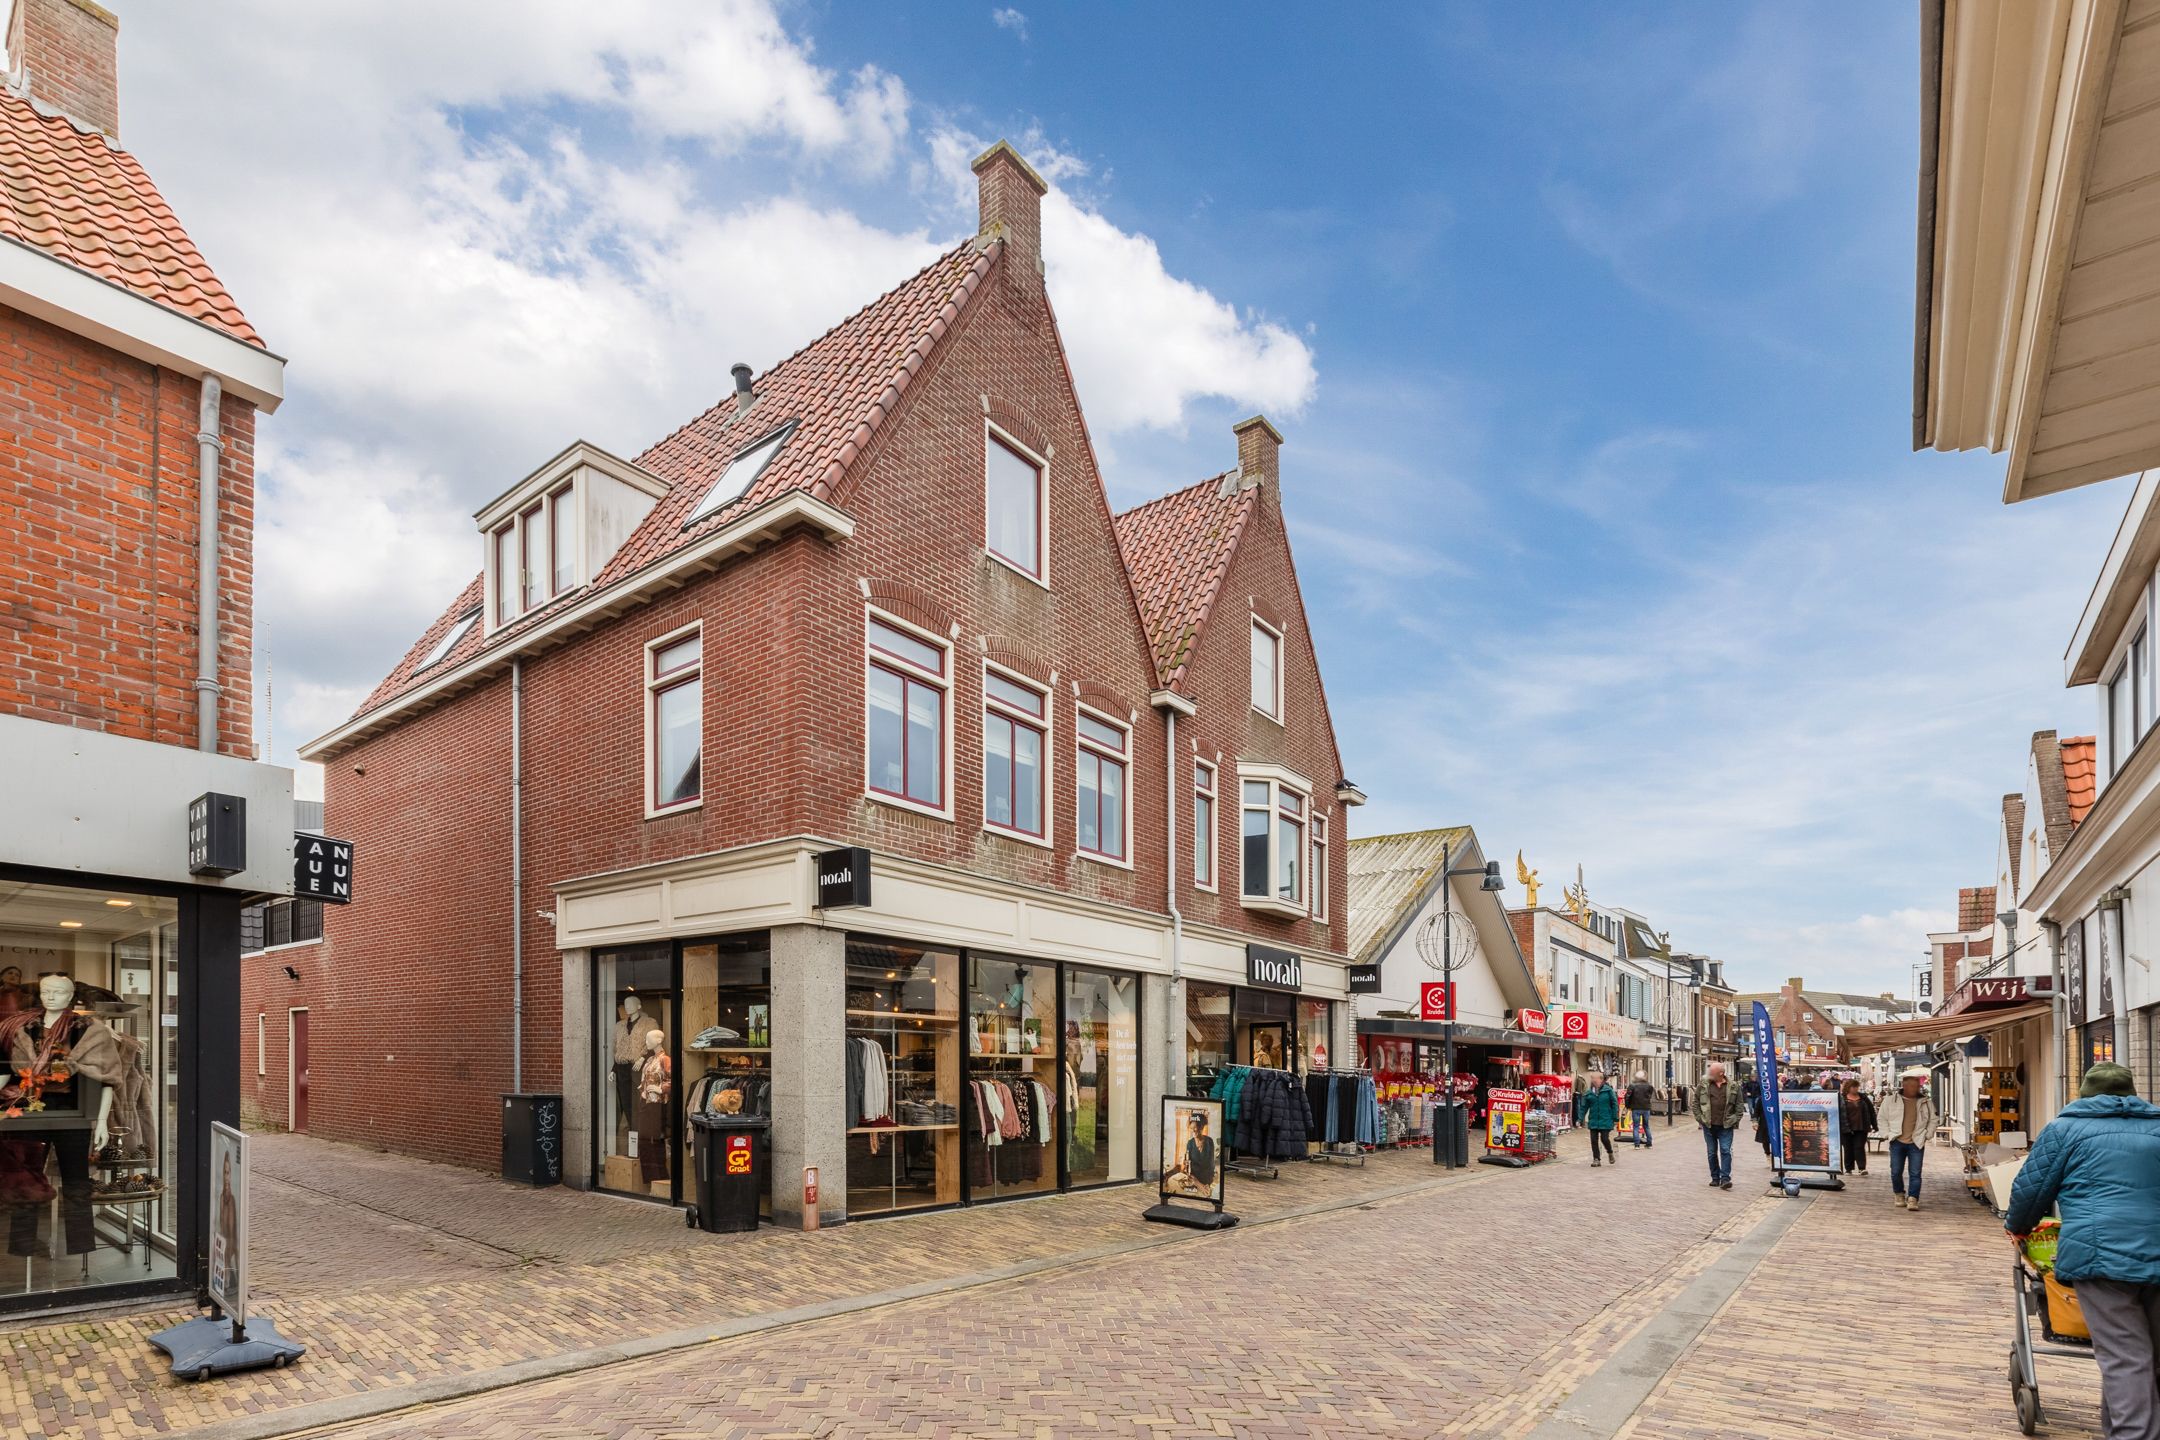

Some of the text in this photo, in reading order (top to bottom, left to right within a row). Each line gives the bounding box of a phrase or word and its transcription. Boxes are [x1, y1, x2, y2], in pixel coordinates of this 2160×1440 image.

[190, 801, 207, 824] VAN
[190, 823, 207, 845] VUU
[190, 845, 207, 866] REN
[820, 867, 852, 886] norah
[294, 877, 348, 896] EN
[1254, 957, 1301, 987] norah
[1351, 973, 1376, 983] norah
[1497, 1090, 1523, 1100] Kruidvat
[1492, 1102, 1521, 1112] ACTIE!
[728, 1164, 750, 1173] Groot
